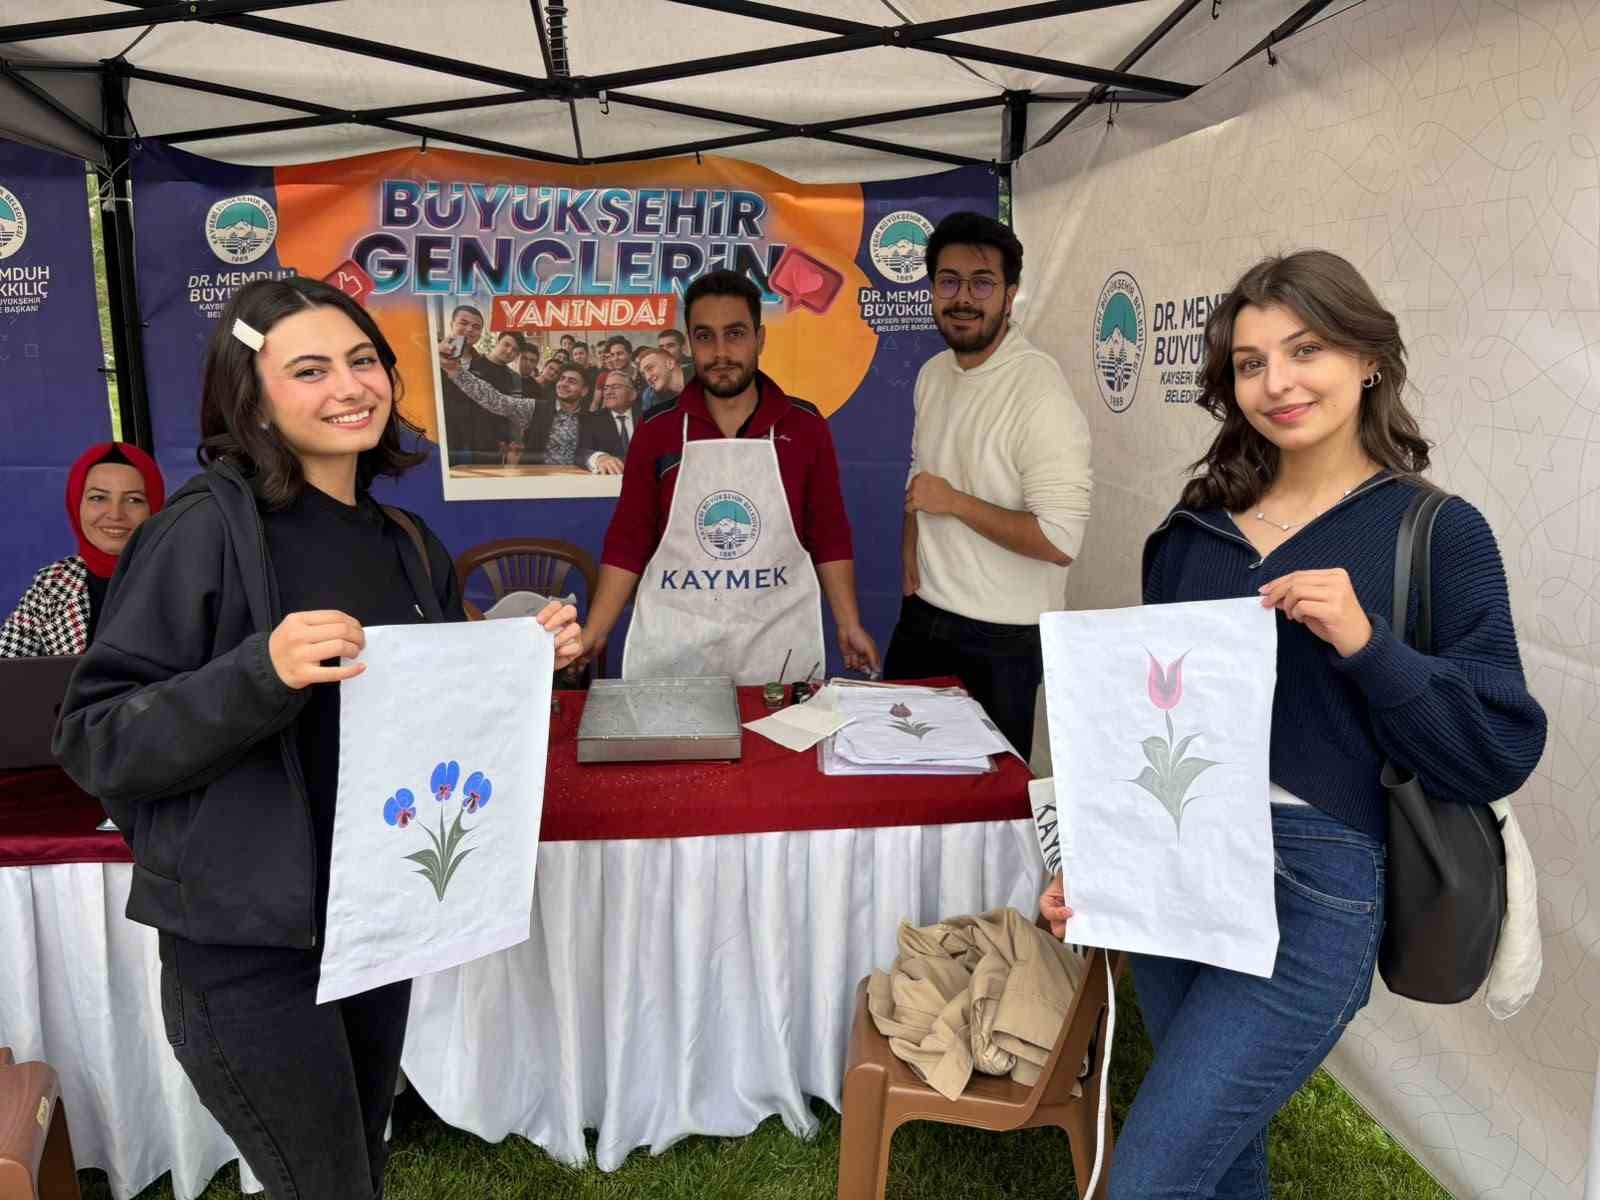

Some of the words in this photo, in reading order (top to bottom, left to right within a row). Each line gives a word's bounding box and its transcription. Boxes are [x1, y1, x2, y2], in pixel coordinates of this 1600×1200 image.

[380, 178, 766, 239] BÜYÜKŞEHİR
[0, 265, 50, 281] MDUH
[187, 275, 213, 288] DR.
[0, 281, 49, 299] KKILIÇ
[861, 289, 885, 303] DR.
[887, 289, 930, 303] MEMD
[500, 298, 668, 327] YANINDA!
[864, 303, 933, 317] BÜYÜKKIL
[1153, 301, 1178, 332] DR.
[1161, 371, 1194, 385] KAYSERİ
[660, 566, 788, 590] KAYMEK
